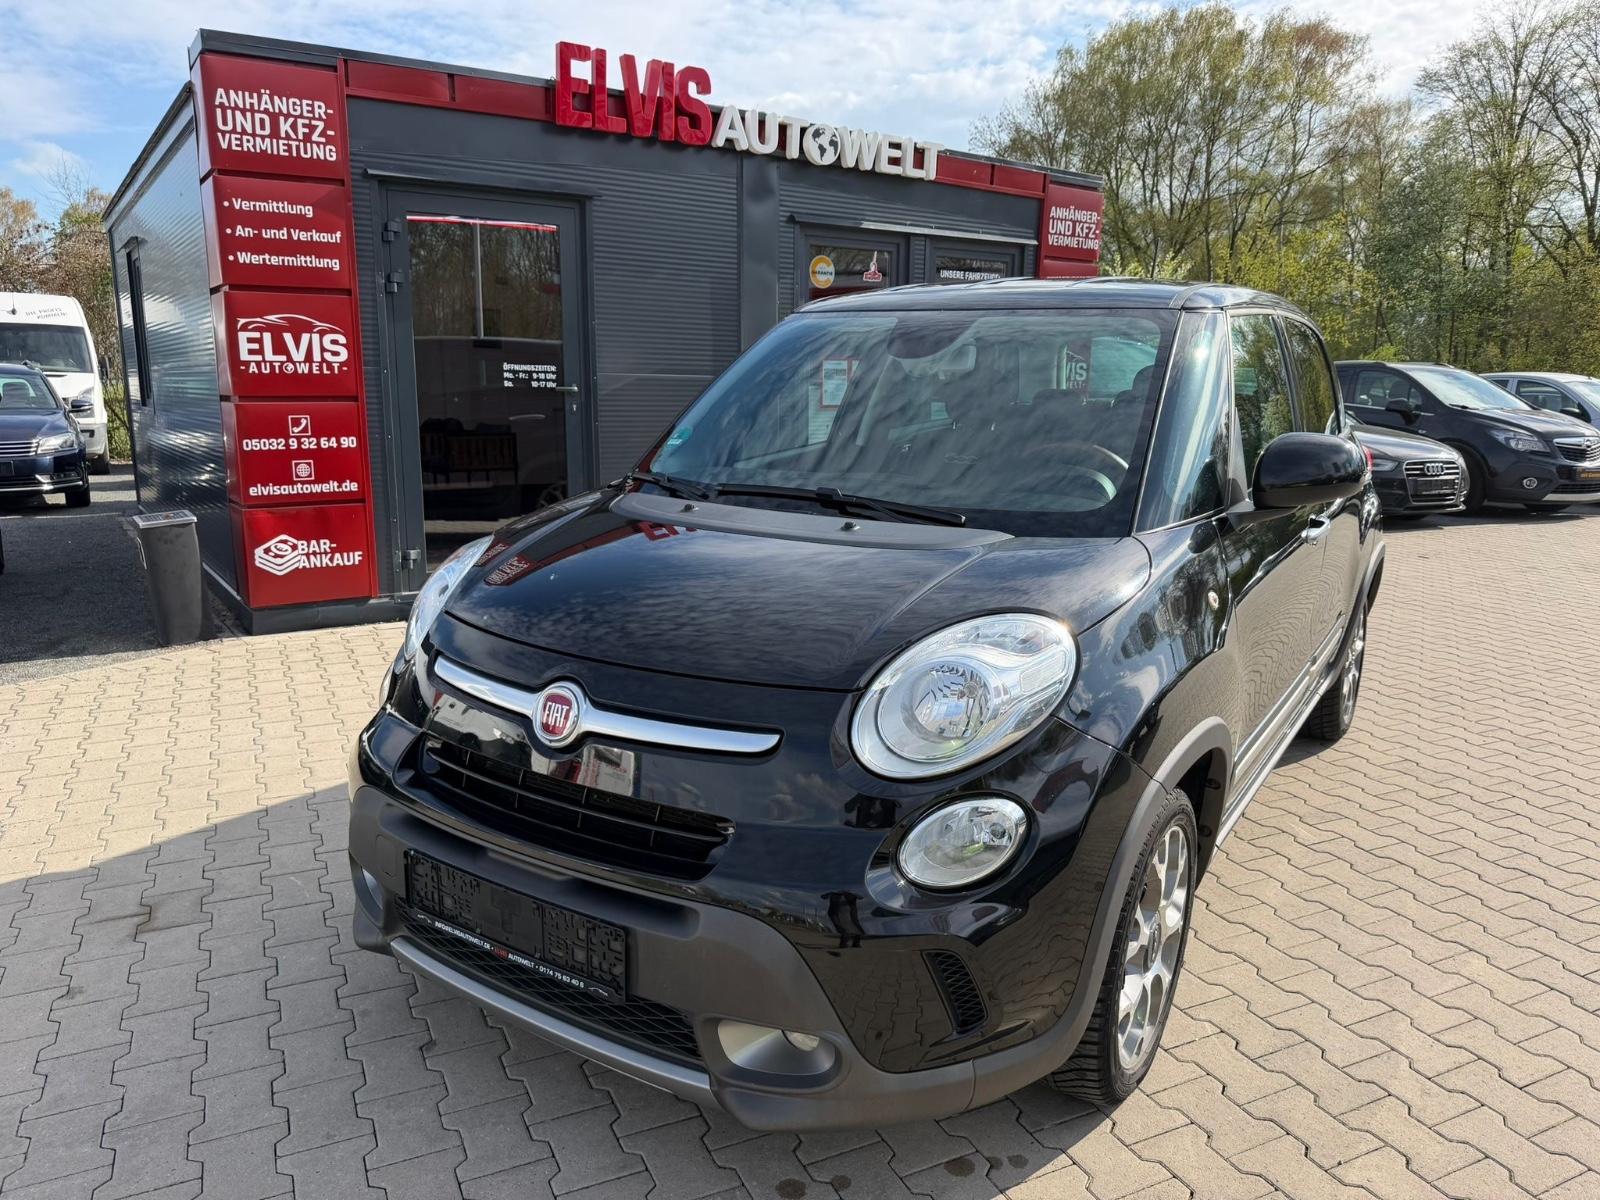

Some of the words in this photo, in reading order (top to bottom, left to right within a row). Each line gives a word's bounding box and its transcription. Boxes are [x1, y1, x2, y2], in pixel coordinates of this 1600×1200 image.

[215, 87, 334, 120] ANHÄNGER-
[555, 41, 713, 146] ELVIS
[216, 108, 271, 136] UND
[280, 116, 335, 142] KFZ-
[217, 132, 337, 161] VERMIETUNG
[711, 104, 944, 181] AUTOWELT
[232, 198, 313, 218] Vermittlung
[1049, 205, 1101, 223] ANHÄNGER-
[235, 225, 258, 237] An-
[262, 226, 287, 240] und
[291, 230, 342, 243] Verkauf
[1048, 219, 1072, 236] UND
[1075, 222, 1100, 239] KFZ-
[1047, 234, 1099, 251] VERMIETUNG
[236, 251, 340, 271] Wertermittlung
[939, 269, 964, 280] UNSERE
[237, 331, 349, 362] ELVIS
[503, 362, 557, 372] ÖFFNUNGSZEITEN:
[242, 437, 286, 451] 05032
[289, 437, 298, 450] 9
[301, 437, 318, 450] 32
[320, 436, 338, 449] 64
[340, 436, 357, 449] 90
[249, 480, 359, 496] elvisautowelt.de
[297, 539, 337, 554] BAR-
[298, 551, 363, 570] ANKAUF
[543, 701, 570, 728] FIAT
